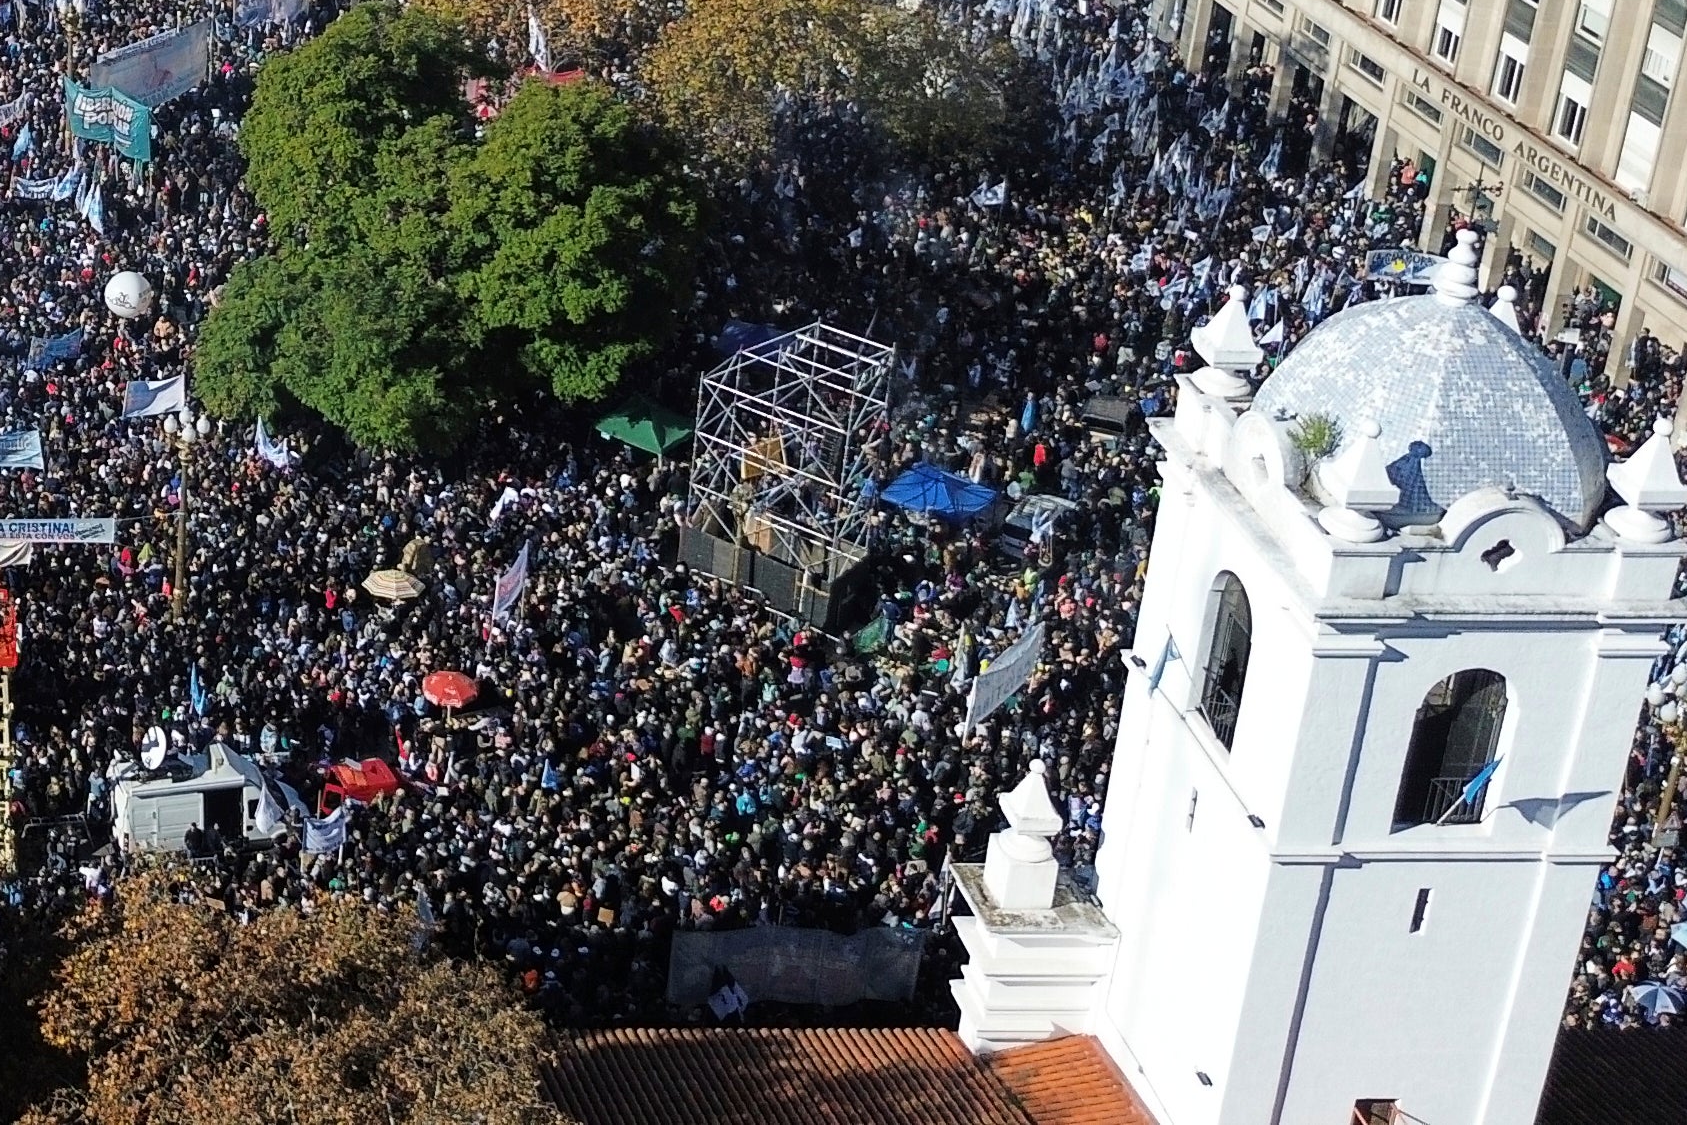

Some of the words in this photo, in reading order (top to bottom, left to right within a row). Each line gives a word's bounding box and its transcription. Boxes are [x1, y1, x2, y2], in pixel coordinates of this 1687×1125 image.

[1412, 69, 1431, 94] LA
[1441, 88, 1504, 141] FRANCO
[1513, 140, 1617, 222] ARGENTINA
[8, 522, 75, 534] CRISTINA!
